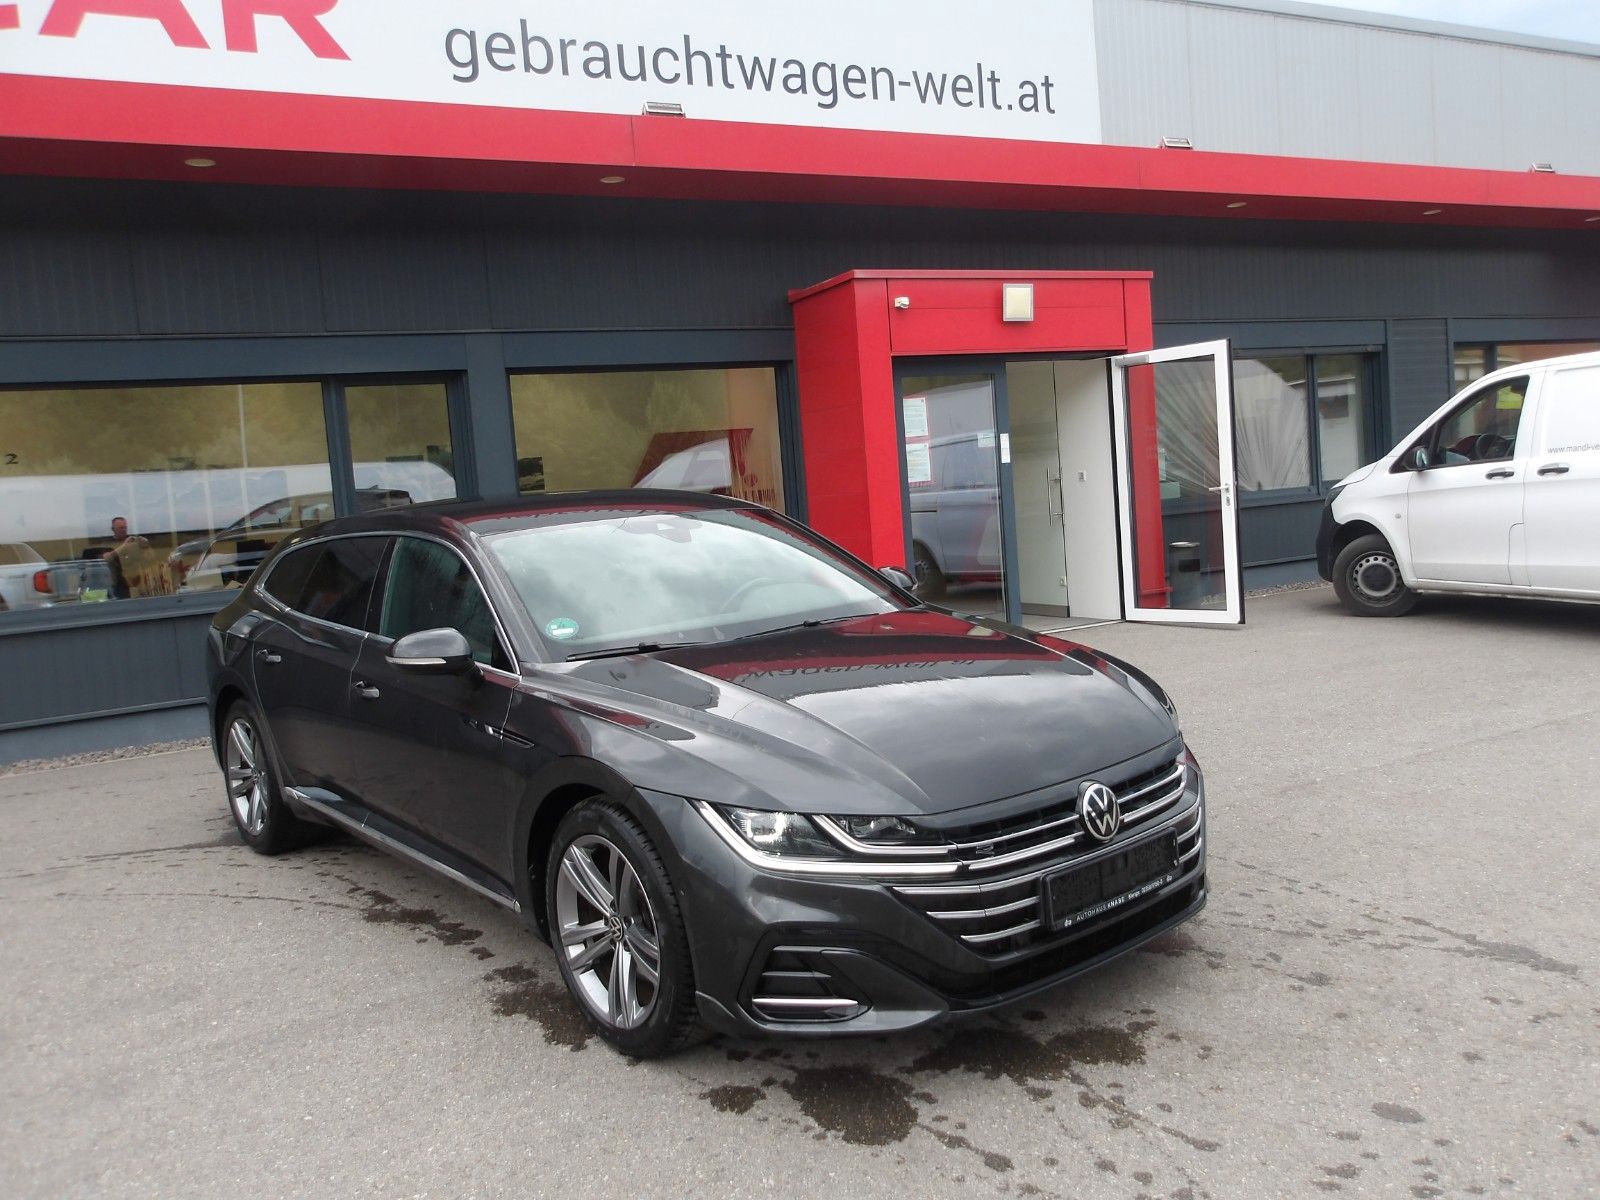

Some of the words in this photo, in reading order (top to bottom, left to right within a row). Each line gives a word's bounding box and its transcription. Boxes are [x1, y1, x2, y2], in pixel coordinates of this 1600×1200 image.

[444, 18, 1057, 115] gebrauchtwagen-welt.at
[1085, 786, 1118, 837] VW
[1076, 904, 1107, 921] AUTOHAUS
